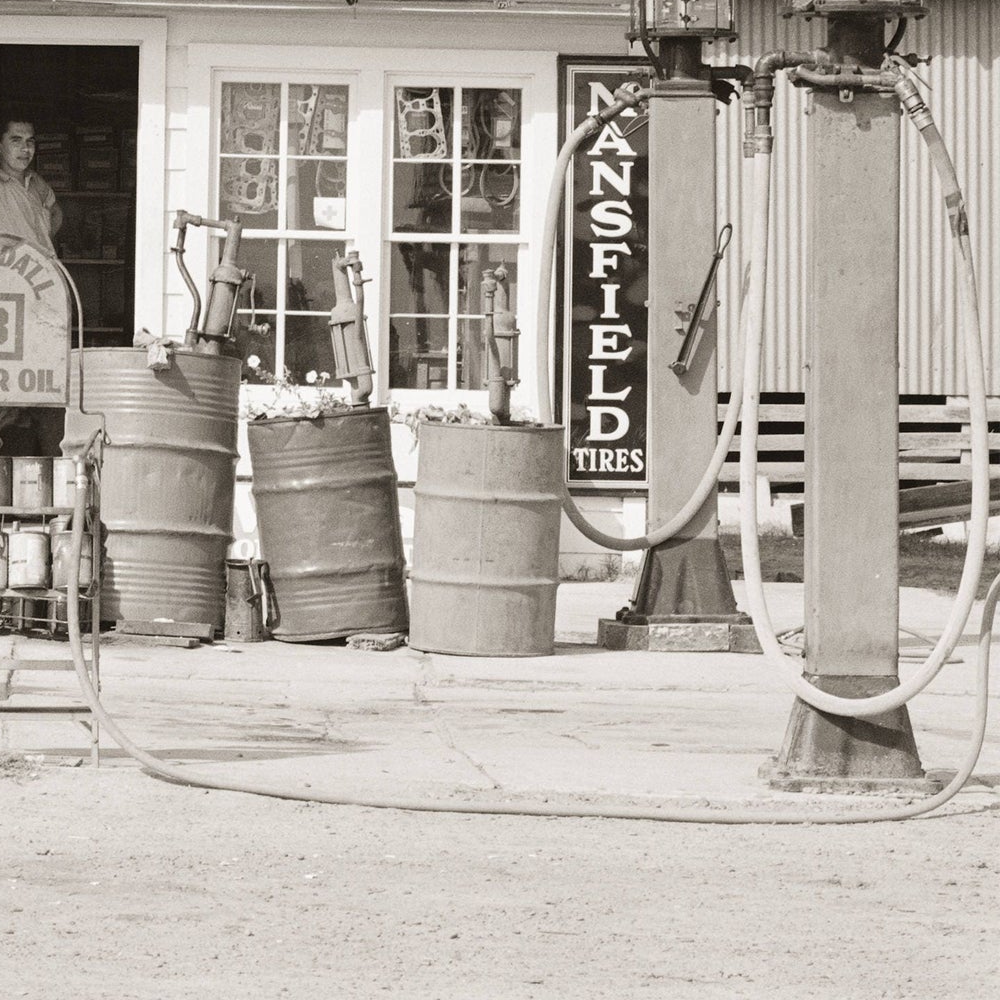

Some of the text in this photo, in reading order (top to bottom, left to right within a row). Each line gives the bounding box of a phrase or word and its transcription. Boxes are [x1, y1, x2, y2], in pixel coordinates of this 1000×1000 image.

[586, 82, 637, 441] MANSFIELD
[18, 368, 61, 393] OIL
[573, 447, 644, 473] TIRES
